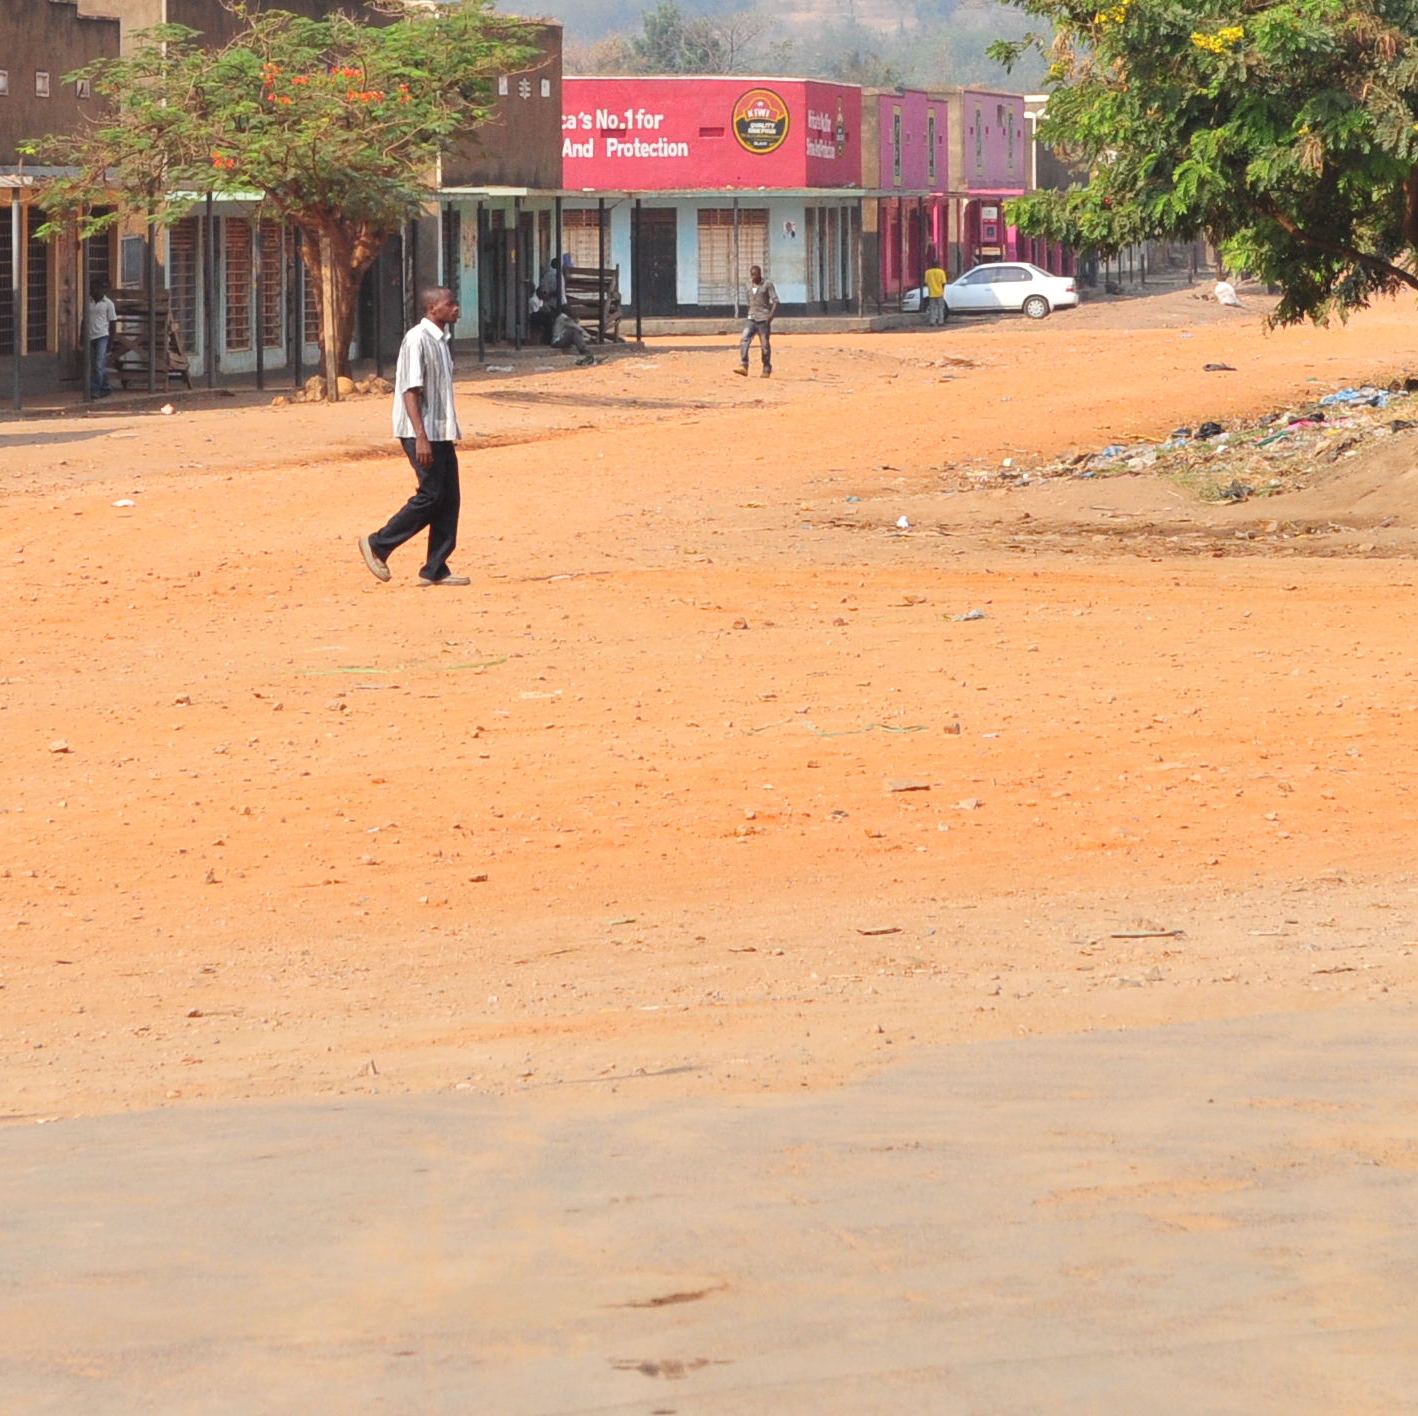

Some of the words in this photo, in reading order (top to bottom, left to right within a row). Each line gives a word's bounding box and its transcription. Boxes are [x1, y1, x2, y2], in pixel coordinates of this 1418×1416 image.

[595, 108, 634, 130] No.1
[635, 108, 664, 130] for
[747, 107, 771, 118] KIWI
[562, 137, 594, 158] And
[606, 137, 689, 158] Protection
